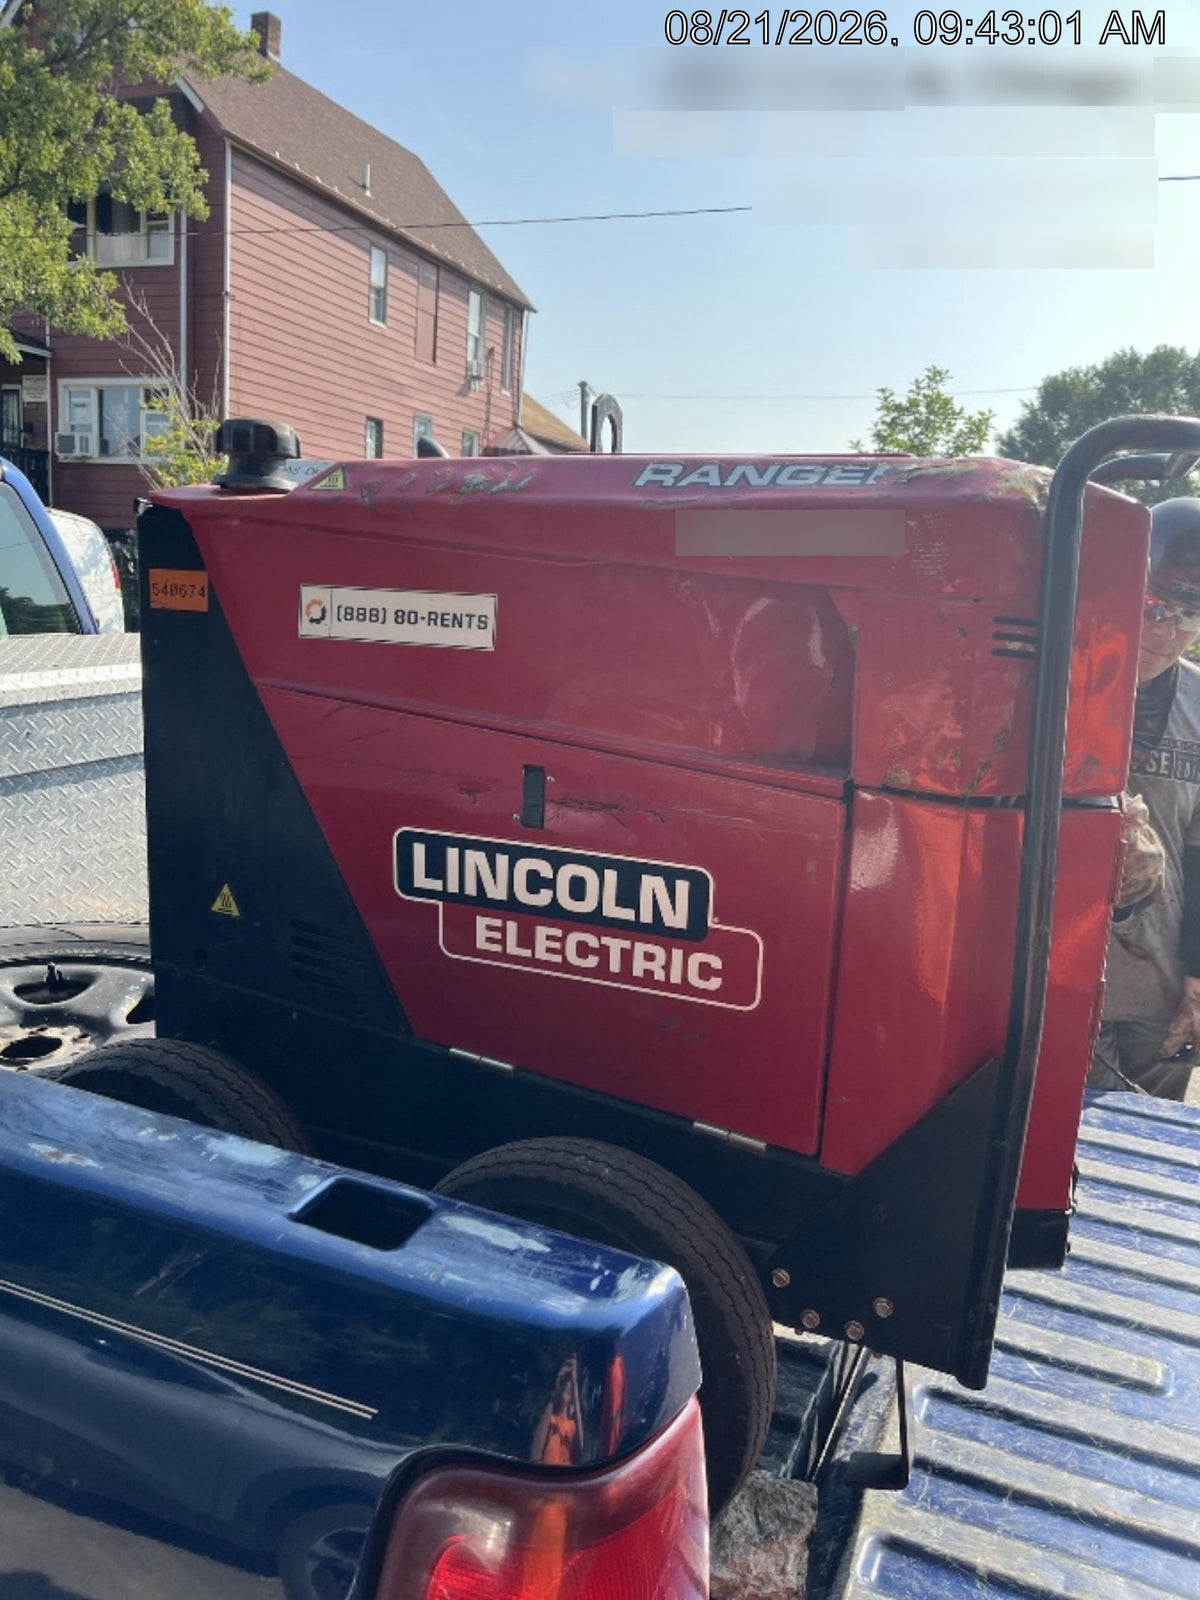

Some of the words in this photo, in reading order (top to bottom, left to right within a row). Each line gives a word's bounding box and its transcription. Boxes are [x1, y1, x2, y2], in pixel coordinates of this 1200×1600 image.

[152, 581, 206, 599] 540674
[336, 604, 387, 625] (888)
[393, 609, 489, 631] 80-RENTS
[412, 842, 691, 930] LINCOLN
[475, 915, 724, 991] ELECTRIC
